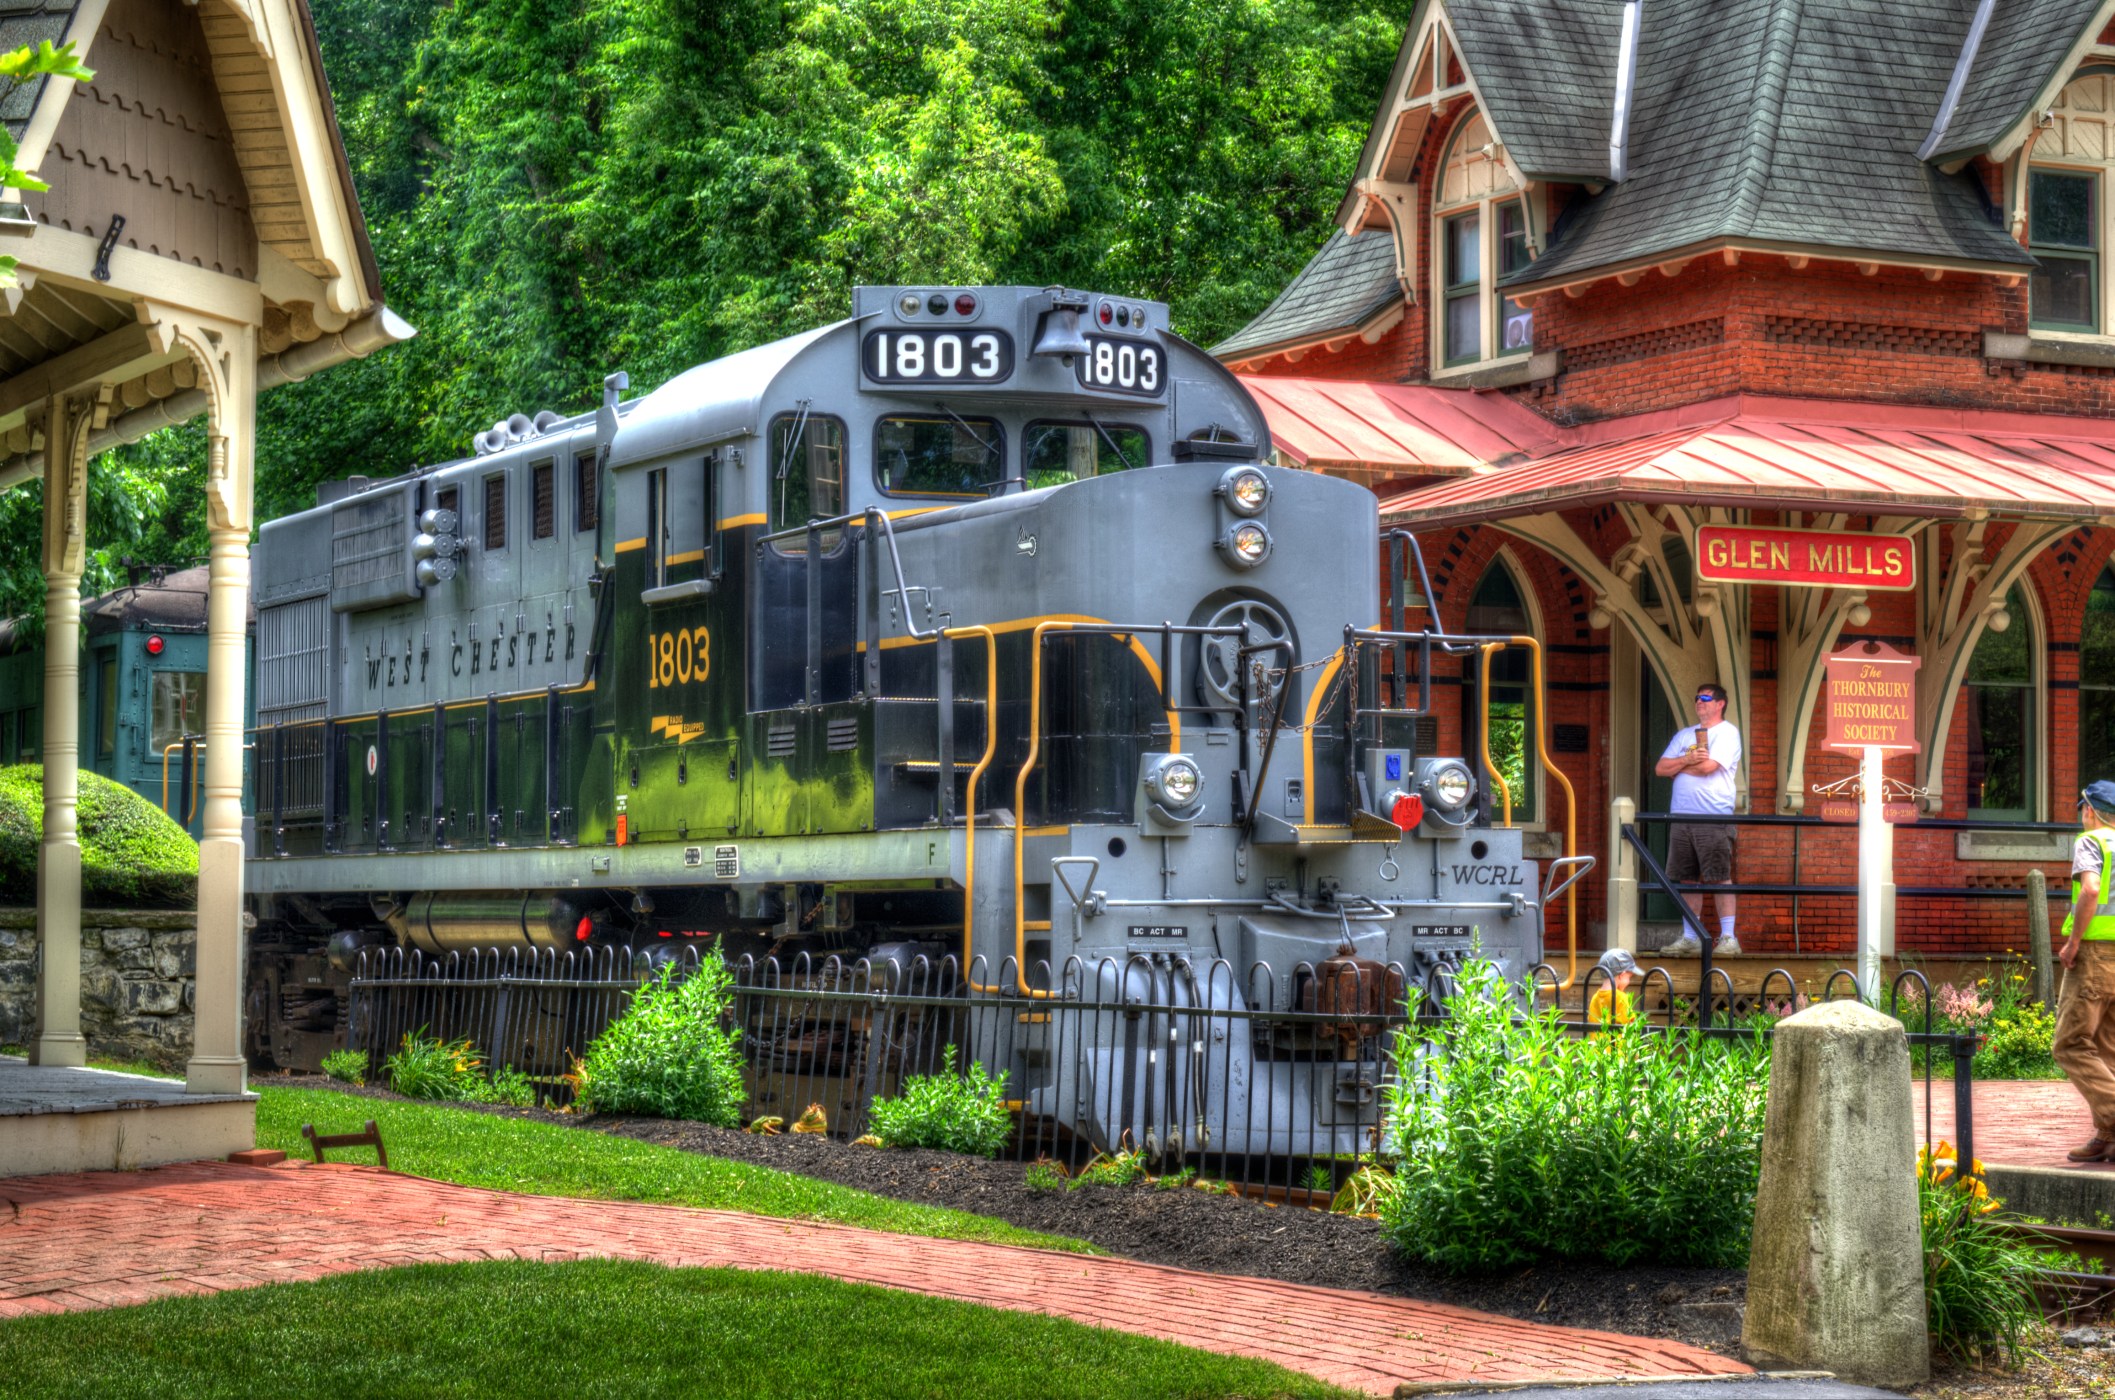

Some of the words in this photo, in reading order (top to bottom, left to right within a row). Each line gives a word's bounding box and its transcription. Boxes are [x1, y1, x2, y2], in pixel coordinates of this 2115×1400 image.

[878, 333, 999, 378] 1803
[1084, 339, 1158, 390] 1803
[1708, 538, 1791, 571] GLEN
[1808, 543, 1903, 576] MILLS
[367, 649, 430, 690] WEST
[451, 624, 576, 678] CHESTER
[649, 625, 710, 688] 1803
[1860, 664, 1882, 679] The
[1832, 680, 1911, 698] THORNBURY
[1833, 702, 1909, 720] HISTORICAL
[683, 722, 705, 732] EQUIPPED
[1843, 723, 1898, 741] SOCIETY
[1823, 807, 1856, 817] CLOSED
[929, 843, 936, 865] F
[1451, 865, 1524, 886] WCRL
[1150, 928, 1165, 936] ACT
[1171, 928, 1183, 936] MR
[1417, 927, 1429, 935] MR
[1433, 927, 1449, 935] ACT
[1453, 927, 1464, 935] BC
